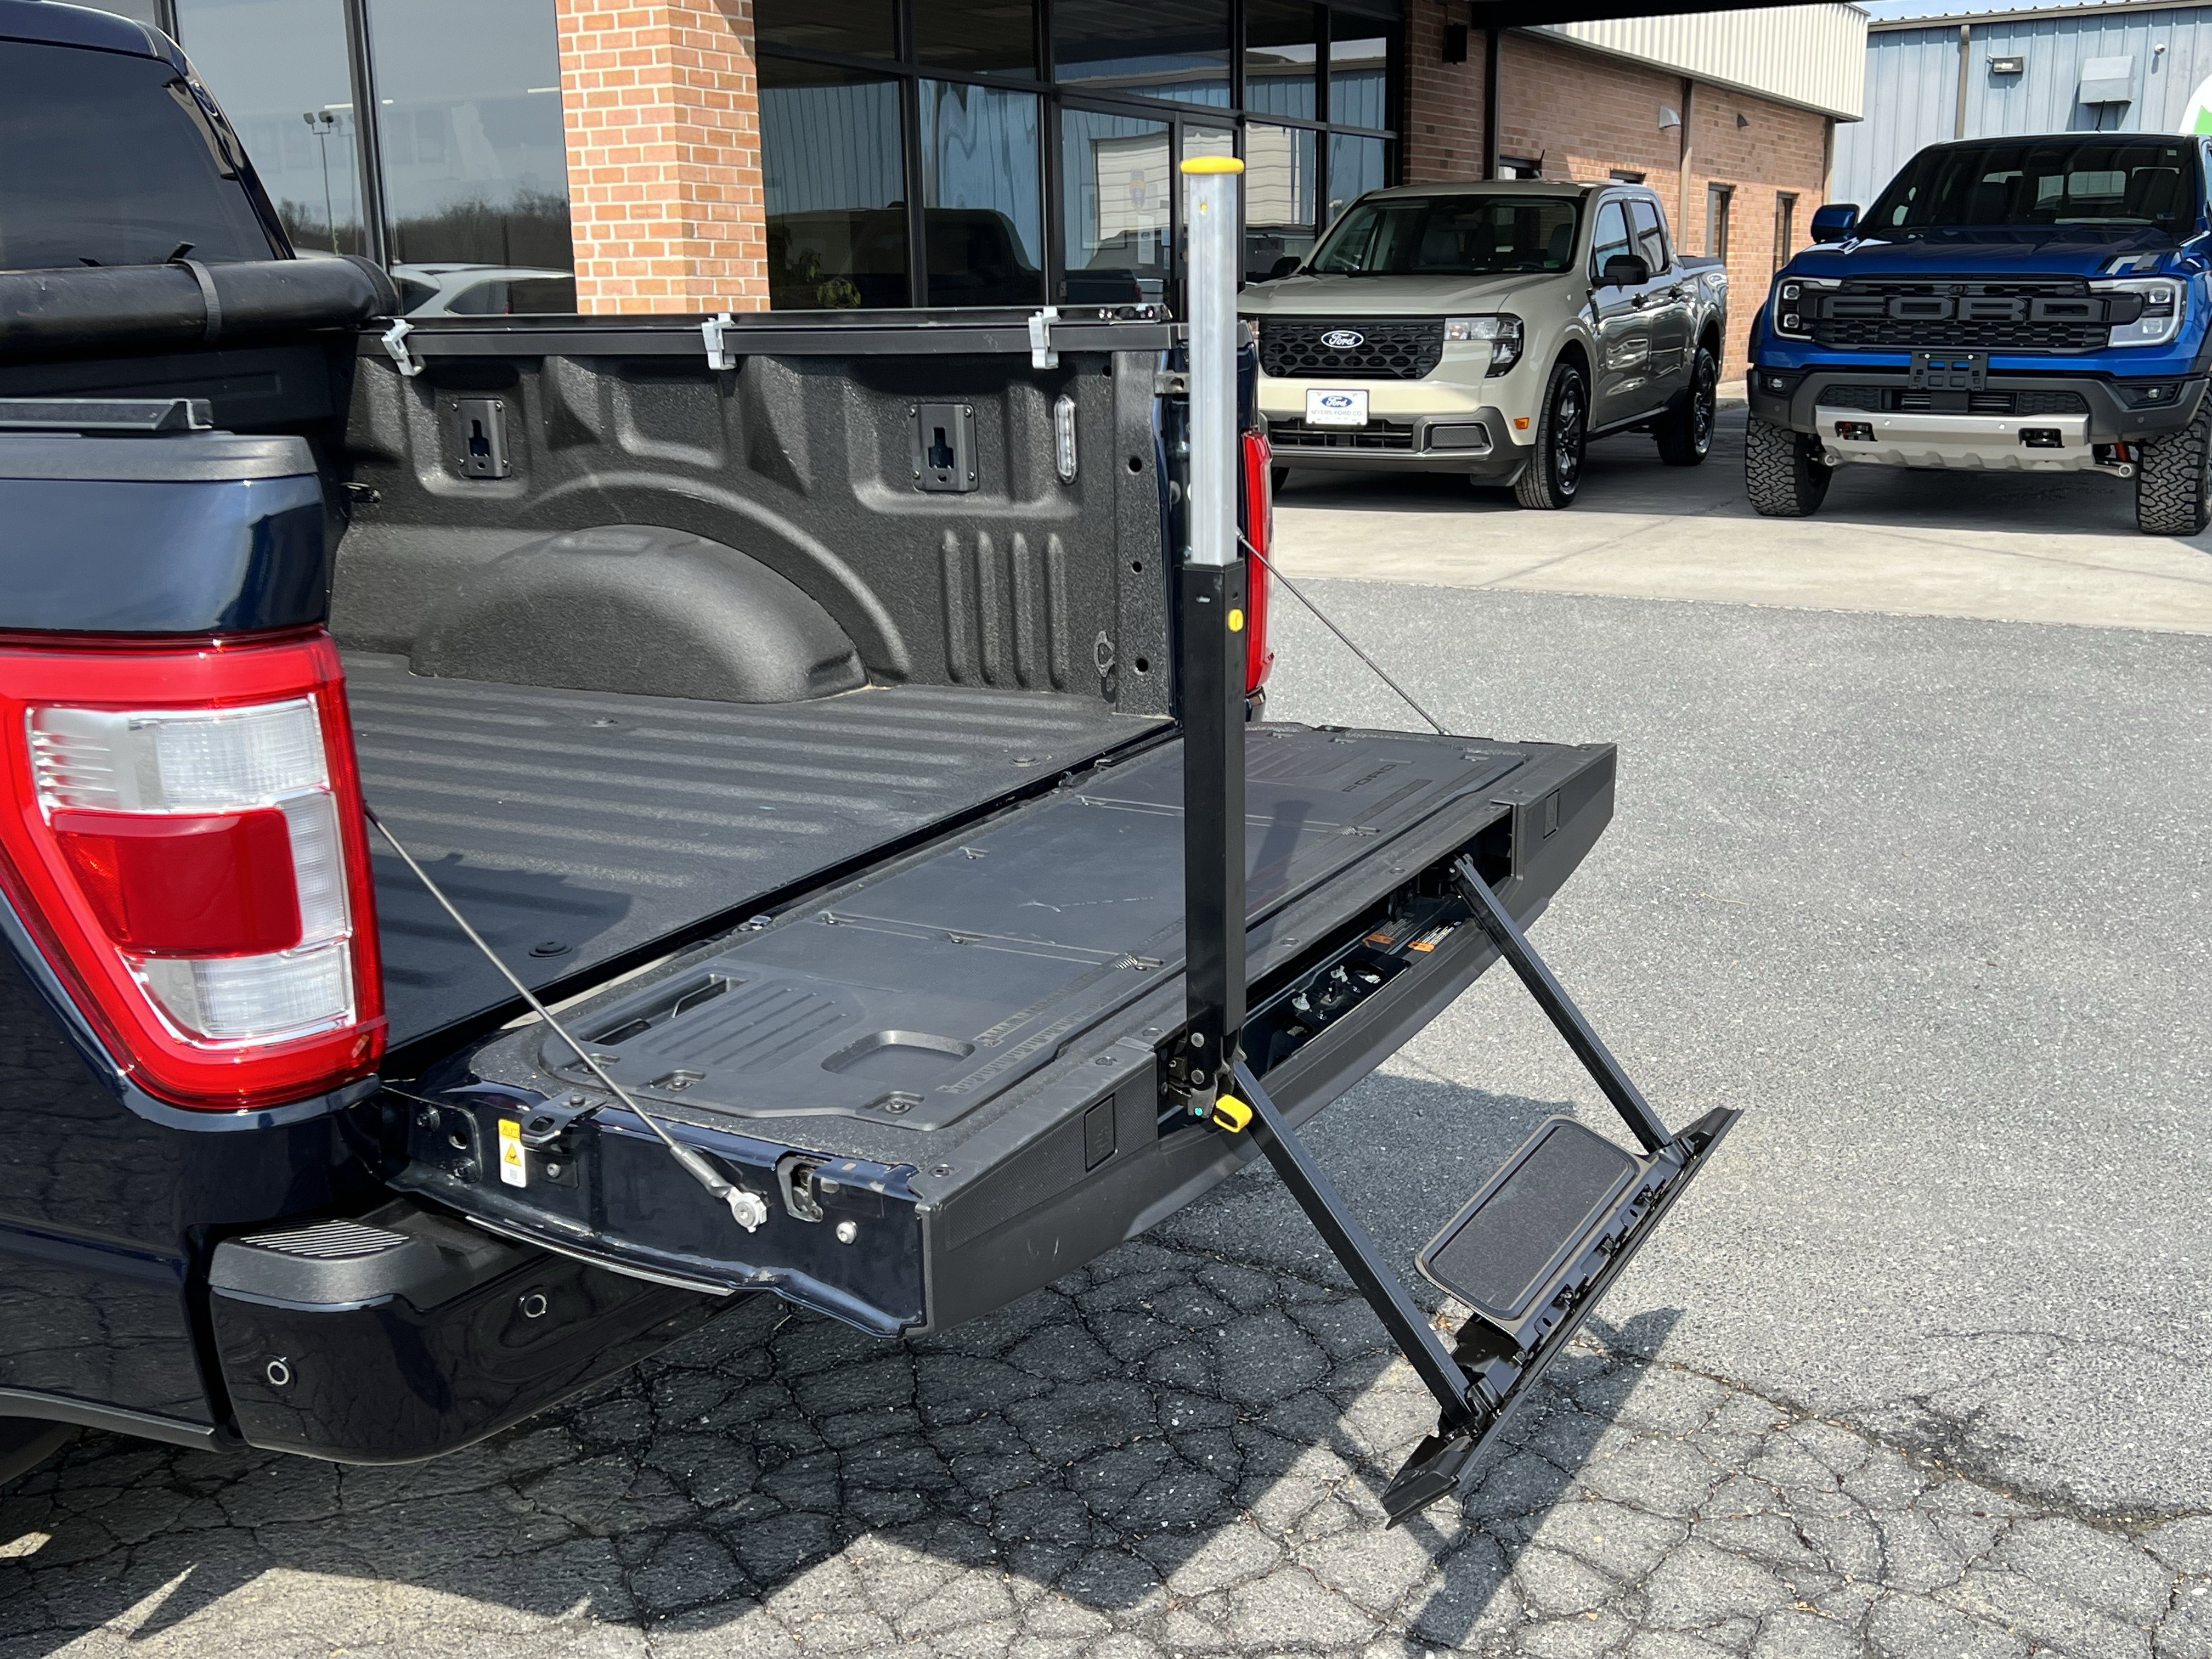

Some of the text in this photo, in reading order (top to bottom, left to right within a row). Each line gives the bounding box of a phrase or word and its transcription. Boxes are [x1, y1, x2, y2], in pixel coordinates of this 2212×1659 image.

[1818, 295, 2110, 322] FORD
[1328, 332, 1356, 346] Ford
[1325, 396, 1348, 408] Ford
[1341, 764, 1397, 792] FORD
